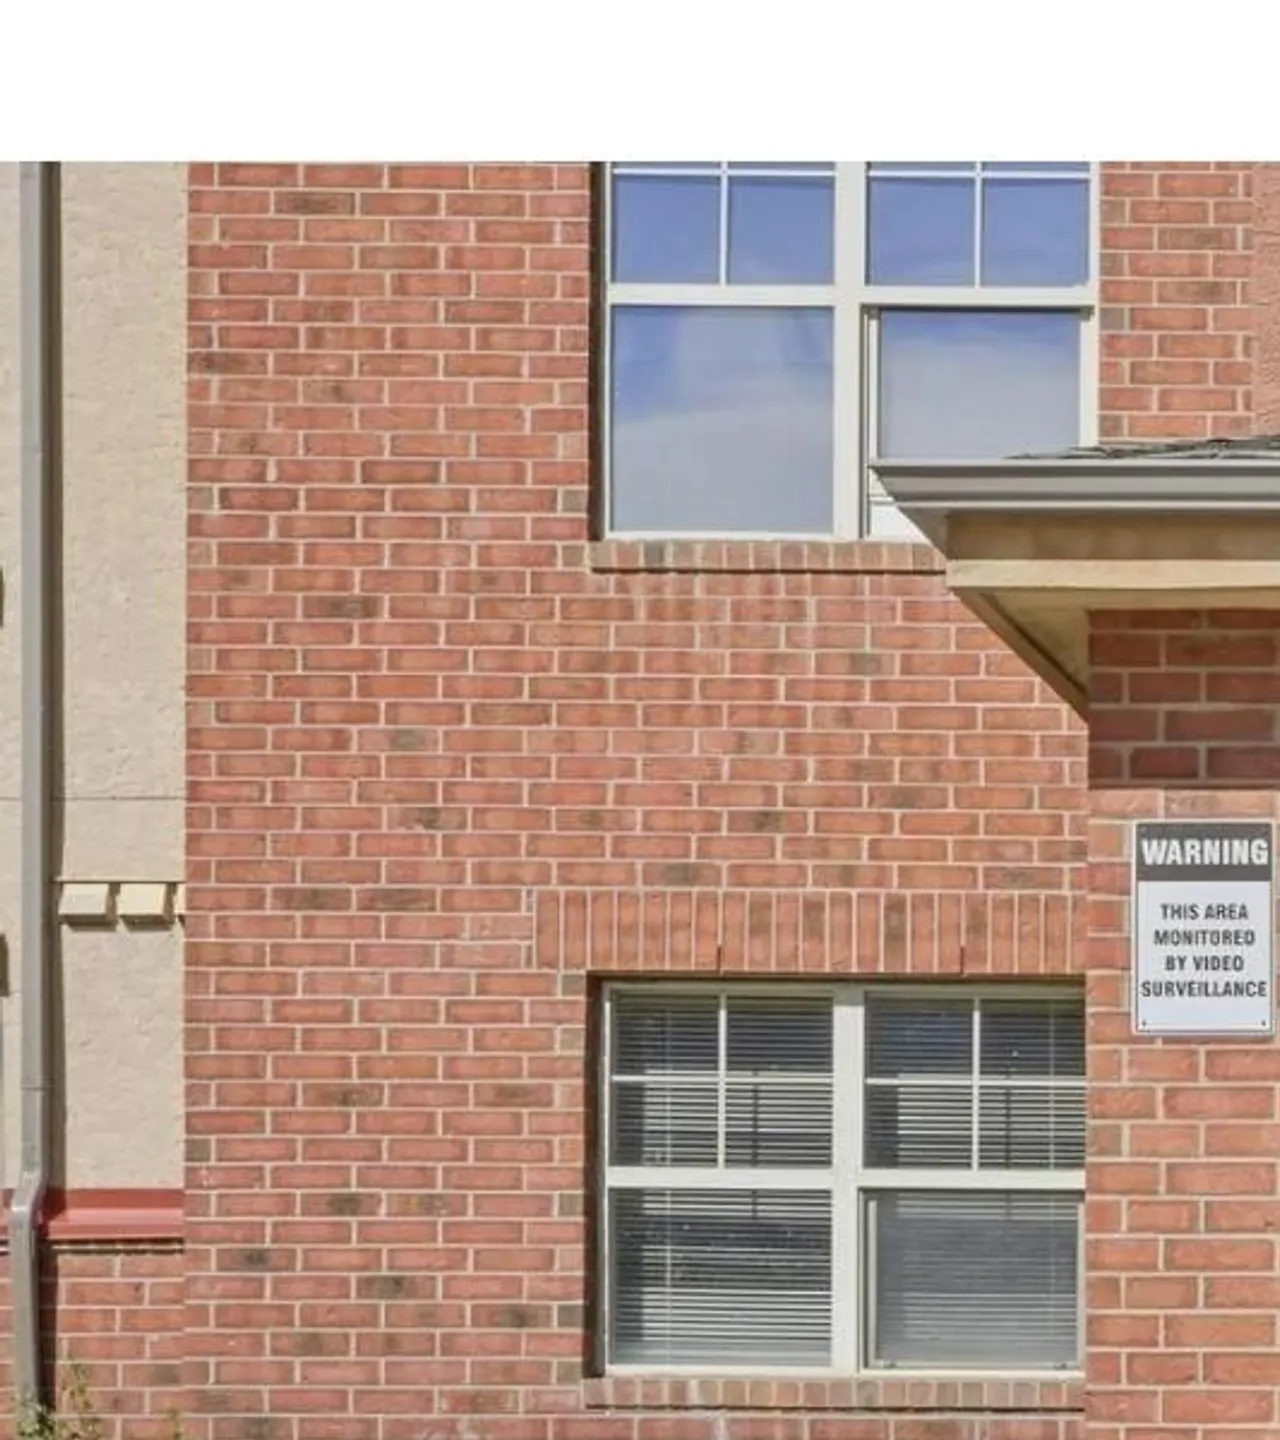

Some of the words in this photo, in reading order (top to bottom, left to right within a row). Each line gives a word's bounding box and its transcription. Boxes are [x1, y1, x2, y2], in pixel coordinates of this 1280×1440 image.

[1141, 839, 1269, 866] WARNING
[1160, 903, 1199, 920] THIS
[1204, 903, 1249, 920] AREA
[1154, 929, 1256, 946] MONITORED
[1164, 955, 1187, 971] BY
[1193, 955, 1244, 971] VIDEO
[1142, 981, 1267, 998] SURVEILLANCE
